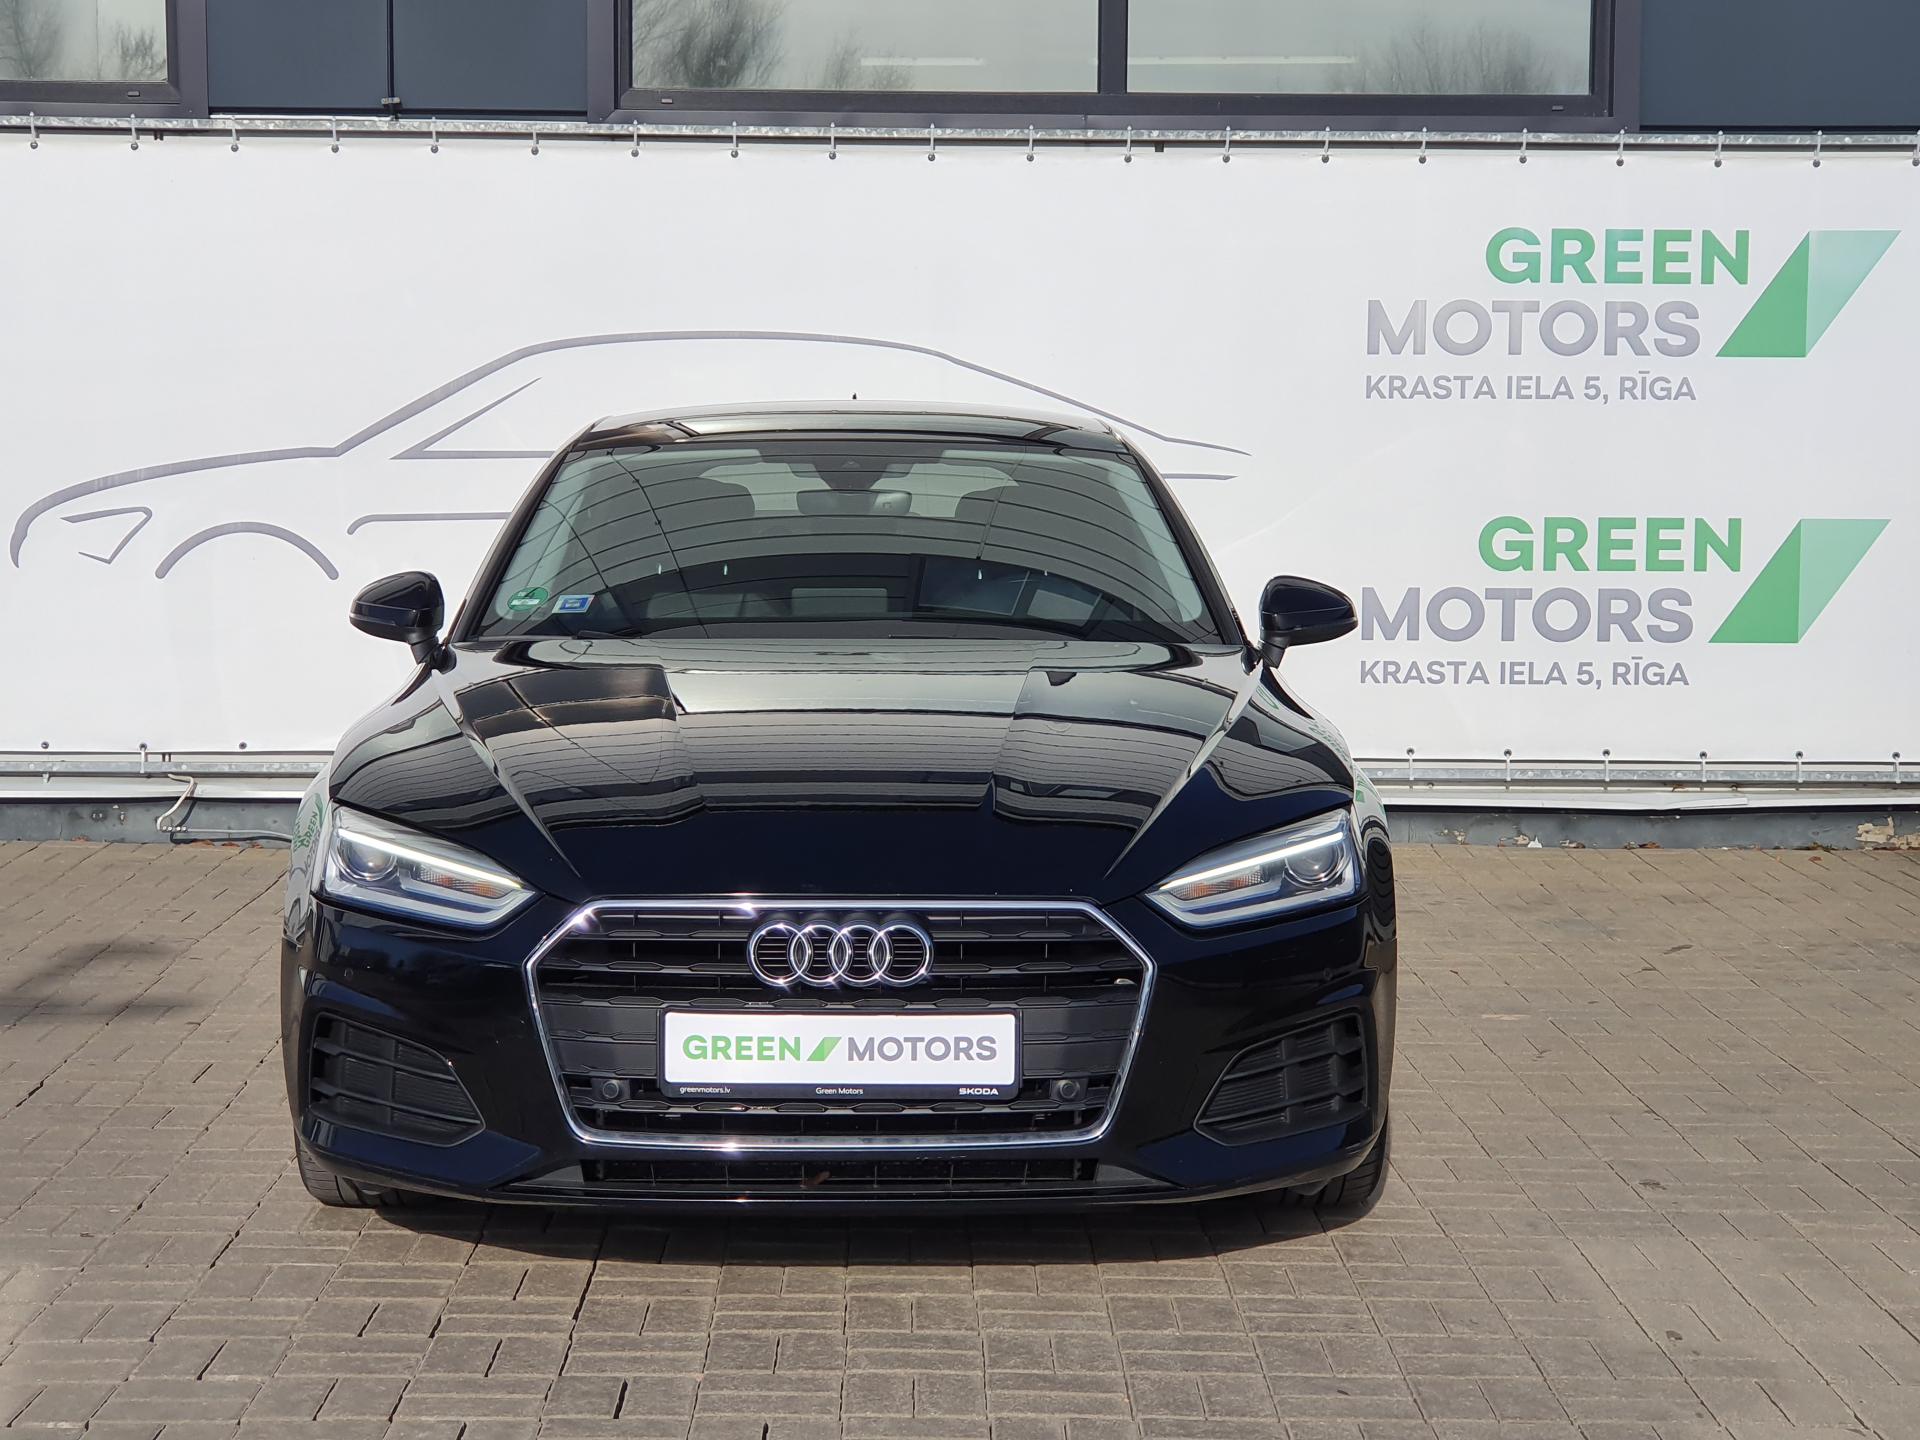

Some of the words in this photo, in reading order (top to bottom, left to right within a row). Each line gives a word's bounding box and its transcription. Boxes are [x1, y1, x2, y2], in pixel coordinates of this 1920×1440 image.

[1485, 227, 1751, 285] GREEN
[1366, 299, 1701, 358] MOTORS
[1365, 375, 1497, 400] KRASTA
[1506, 375, 1575, 400] IELA
[1583, 376, 1609, 405] 5,
[1618, 371, 1697, 400] RĪGA
[1478, 515, 1743, 573] GREEN
[1360, 586, 1694, 643] MOTORS
[1360, 660, 1490, 686] KRASTA
[1499, 660, 1568, 686] IELA
[1576, 661, 1603, 690] 5,
[1611, 656, 1690, 686] RĪGA
[682, 1033, 802, 1062] GREEN
[847, 1035, 998, 1063] MOTORS
[679, 1086, 731, 1095] greenmotors.lv
[815, 1086, 838, 1095] Green
[839, 1086, 864, 1096] Motors
